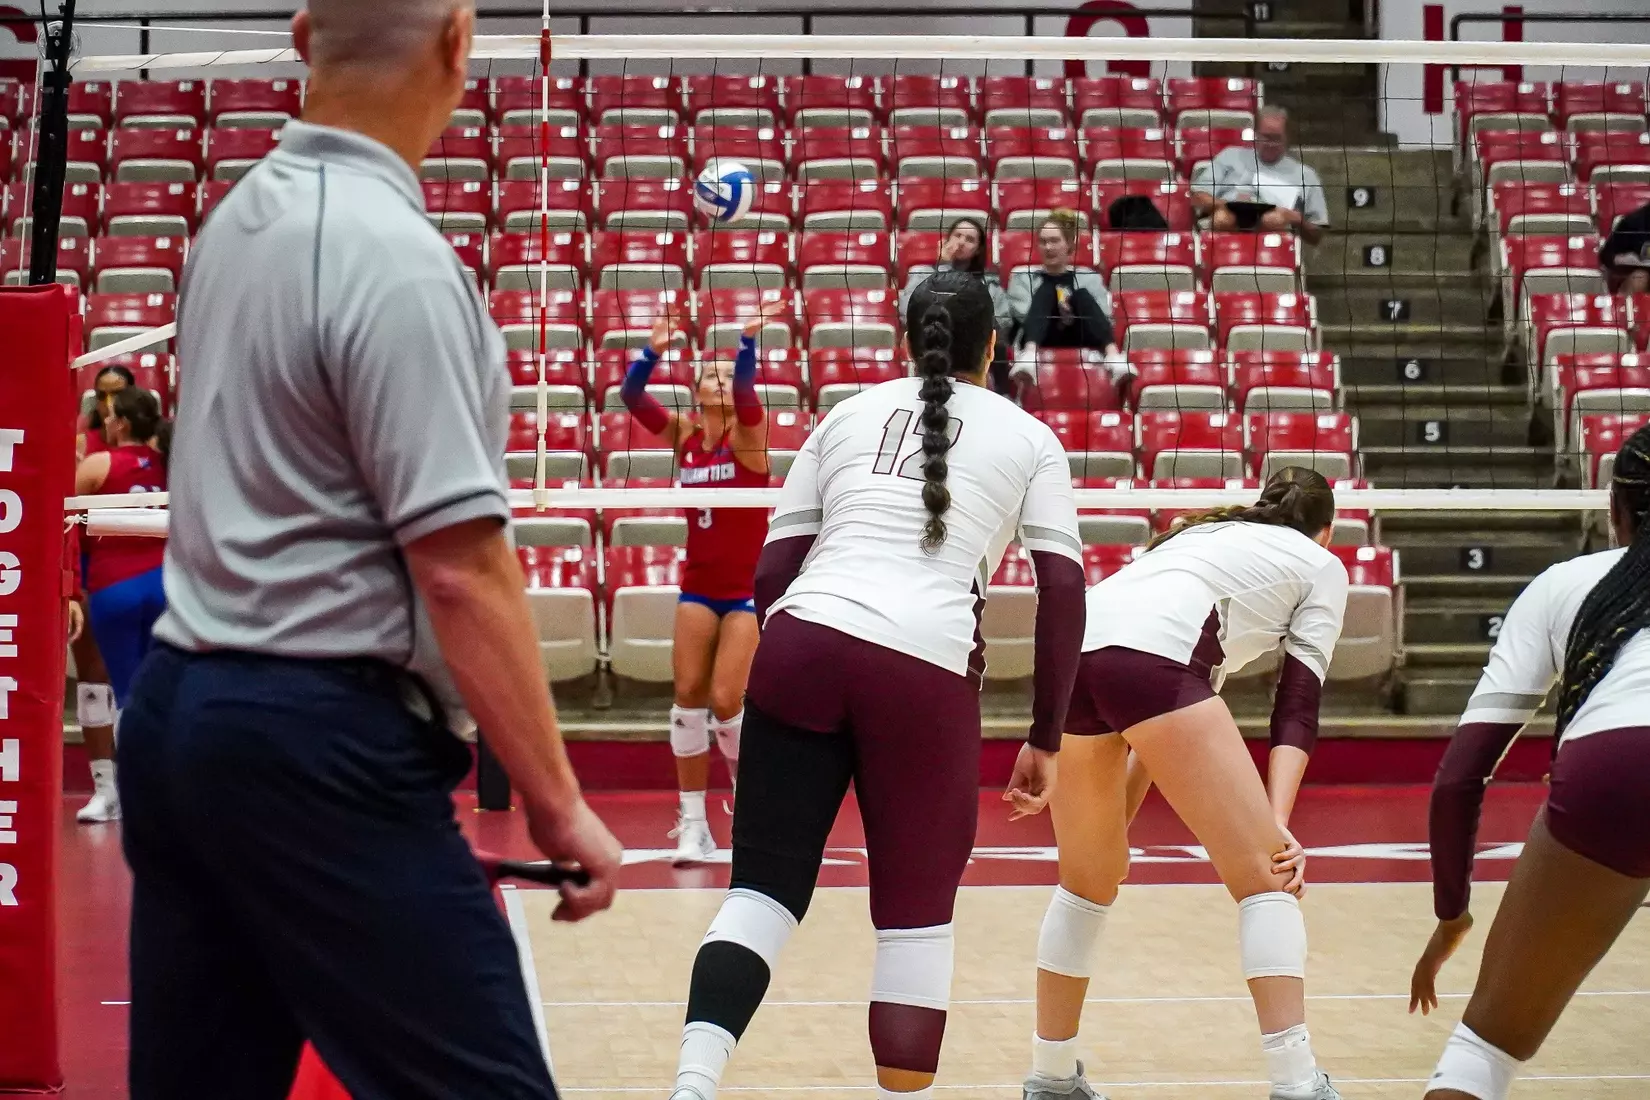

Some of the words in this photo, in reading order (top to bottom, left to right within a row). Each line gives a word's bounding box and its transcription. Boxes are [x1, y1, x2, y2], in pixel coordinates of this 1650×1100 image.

[1353, 188, 1369, 207] 9
[1370, 246, 1385, 265] 8
[1387, 300, 1402, 320] 7
[1404, 360, 1420, 379] 6
[1424, 421, 1440, 441] 5
[872, 408, 963, 483] 12
[1468, 548, 1484, 569] 3
[1488, 616, 1503, 637] 2
